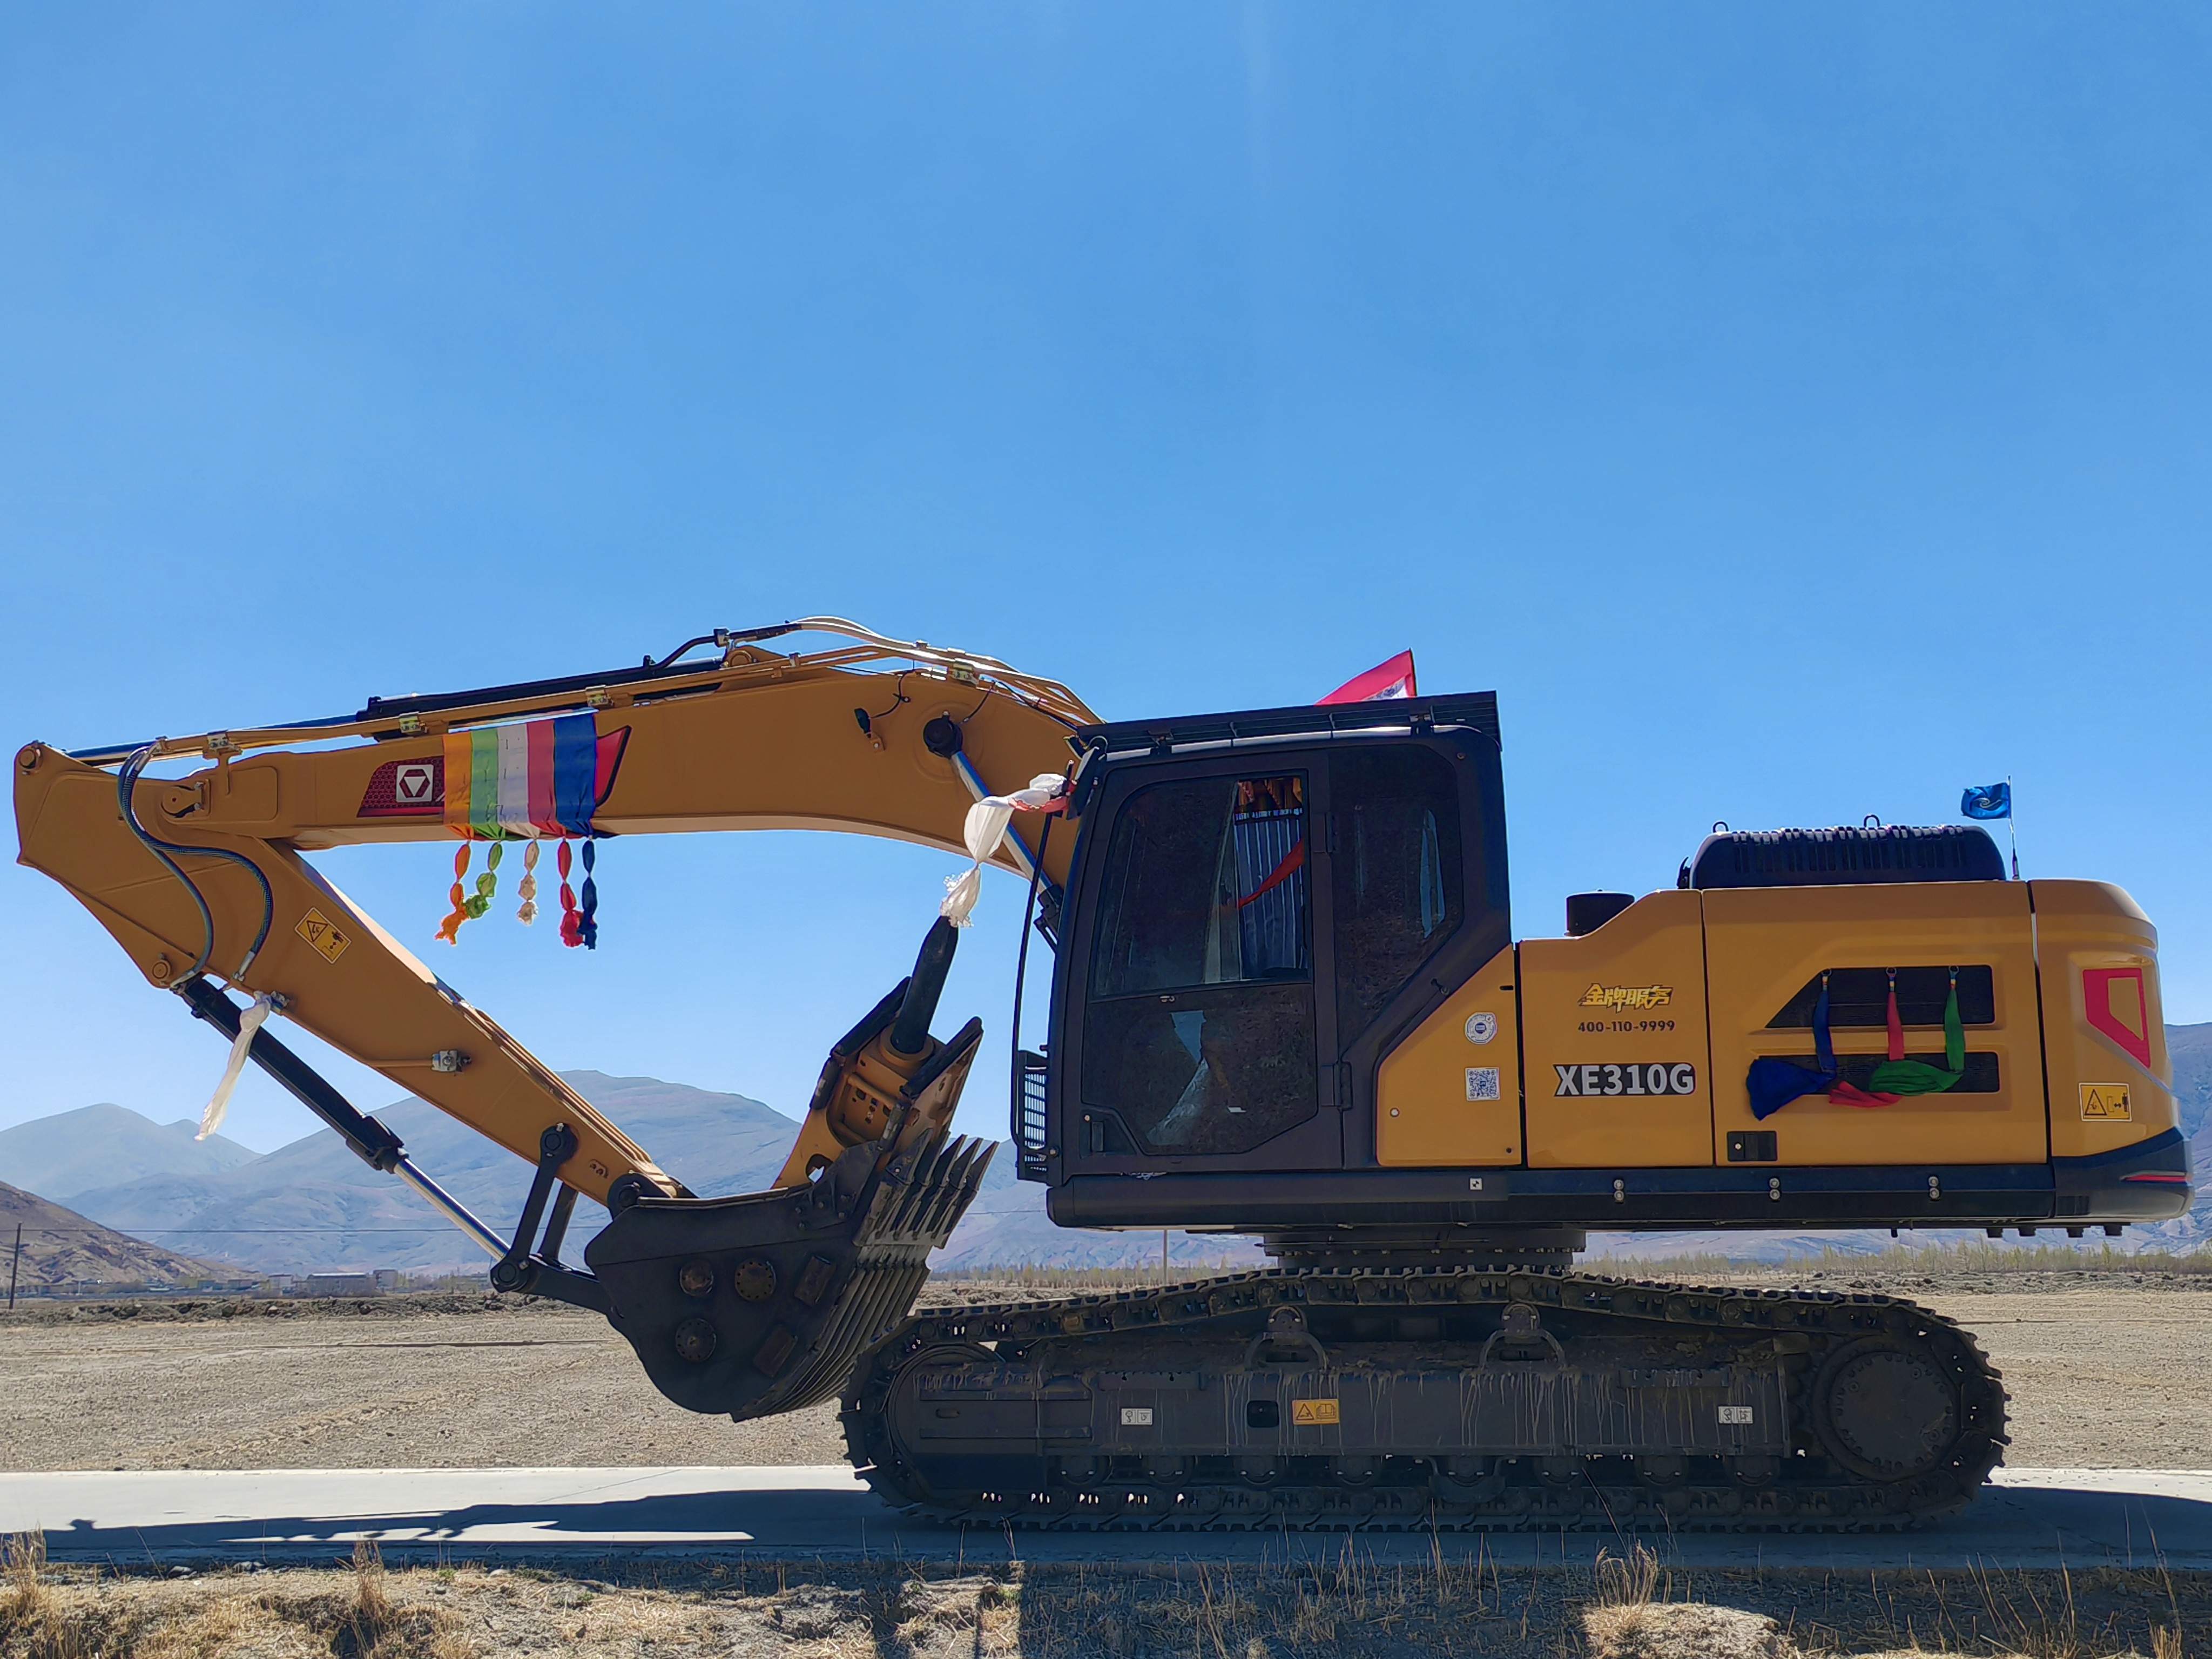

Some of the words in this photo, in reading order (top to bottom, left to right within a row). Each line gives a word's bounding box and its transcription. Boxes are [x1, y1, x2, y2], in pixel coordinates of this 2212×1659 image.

[1578, 983, 1673, 1013] 金牌服务
[1578, 1020, 1675, 1032] 400-110-9999
[1555, 1063, 1694, 1095] XE310G
